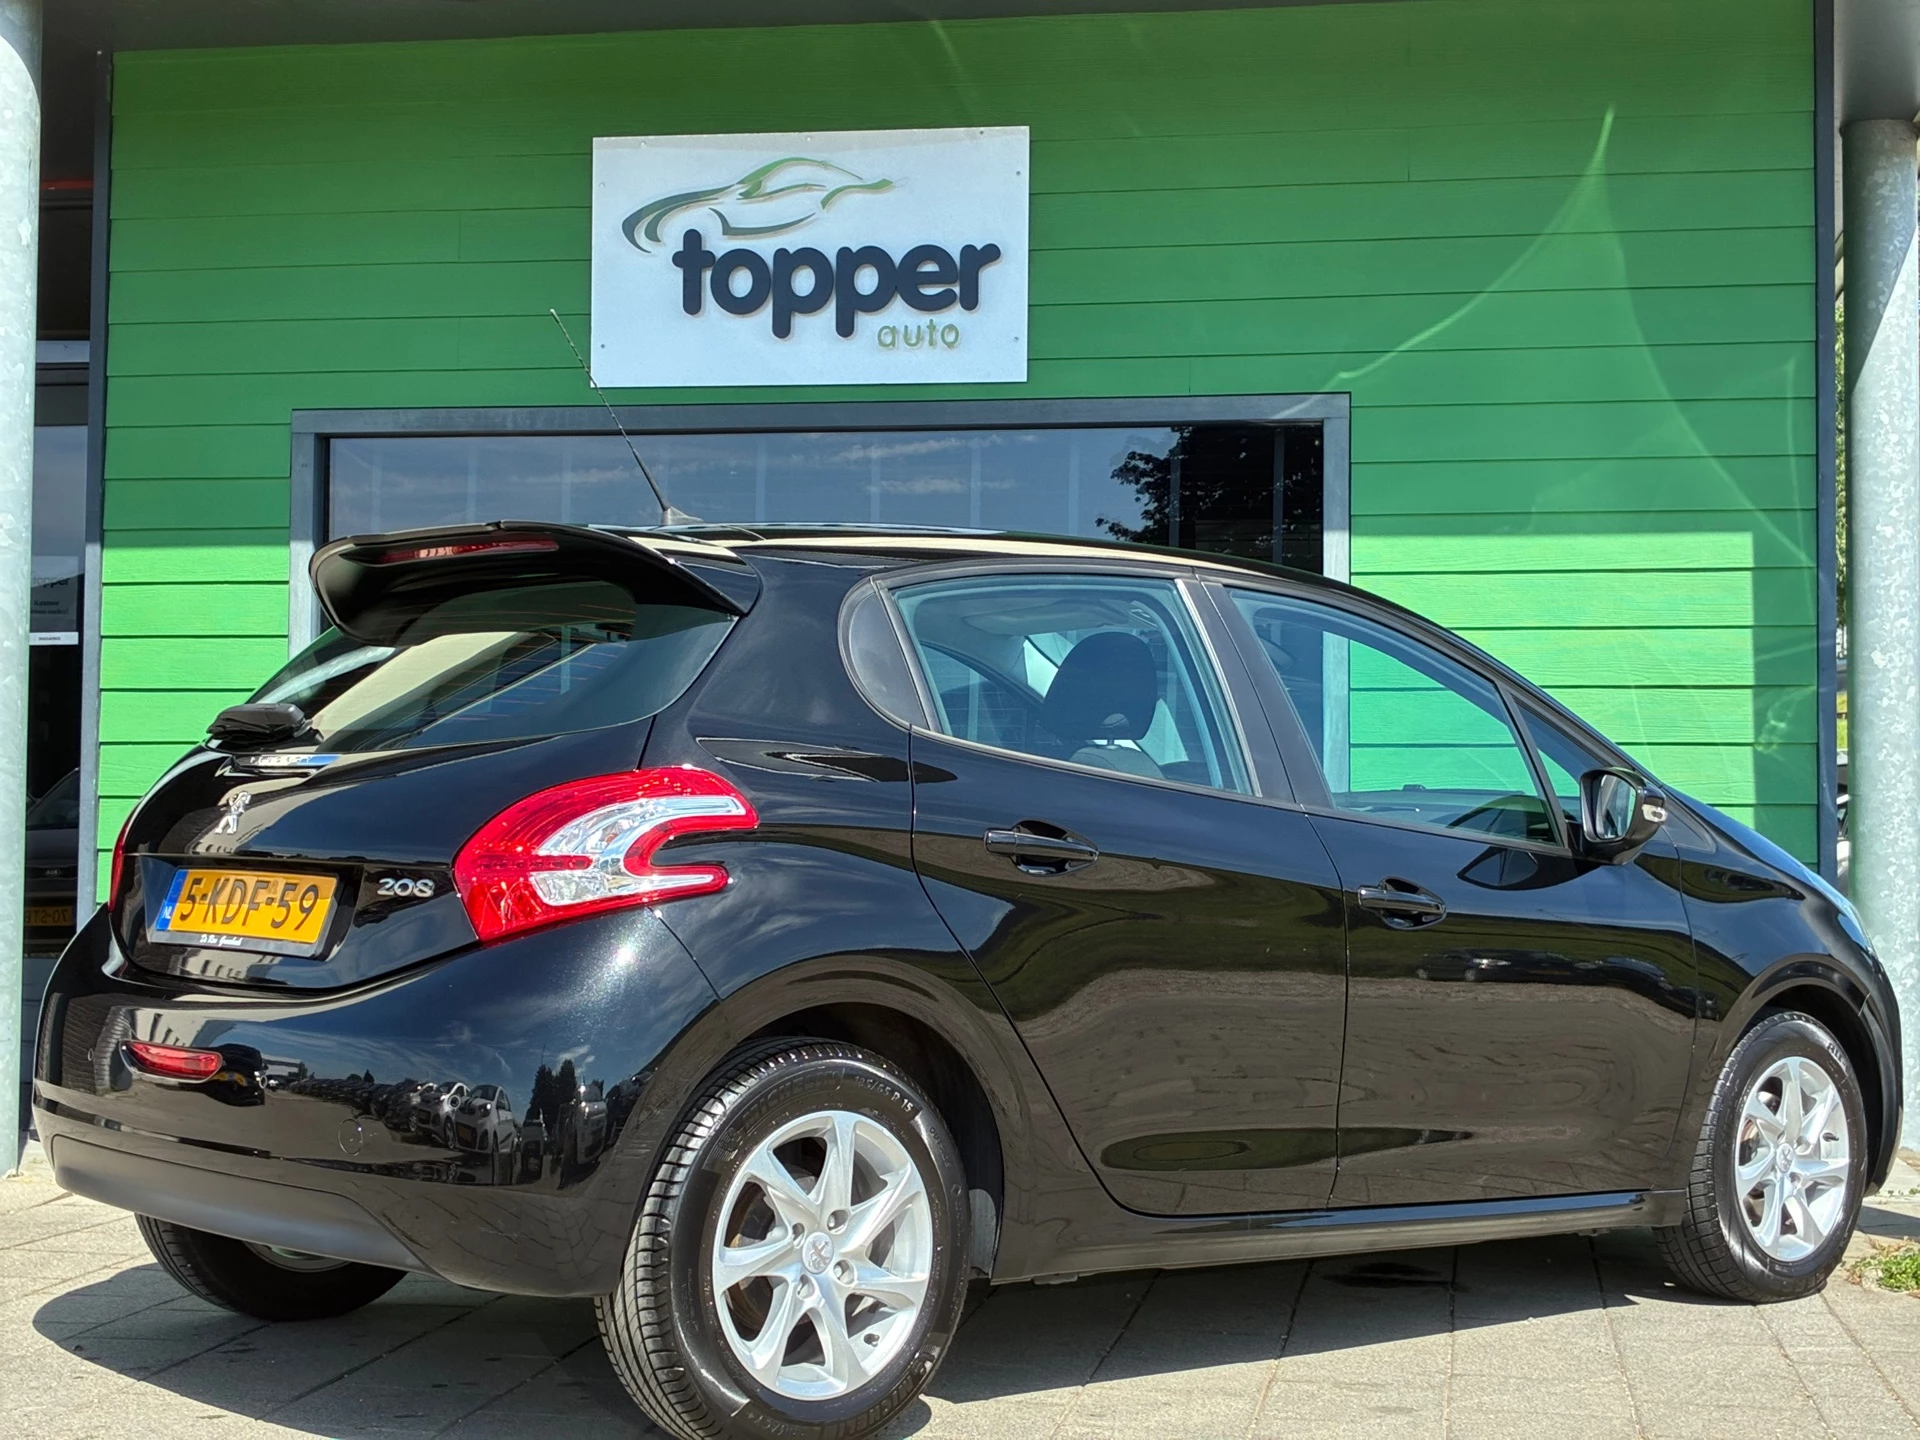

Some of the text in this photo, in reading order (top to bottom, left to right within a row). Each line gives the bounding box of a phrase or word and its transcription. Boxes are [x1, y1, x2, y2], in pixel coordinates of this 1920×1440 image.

[671, 227, 1002, 340] topper
[876, 318, 961, 350] auto
[377, 877, 435, 898] 208
[179, 876, 320, 932] 5-KDF-59
[901, 1098, 915, 1113] 15
